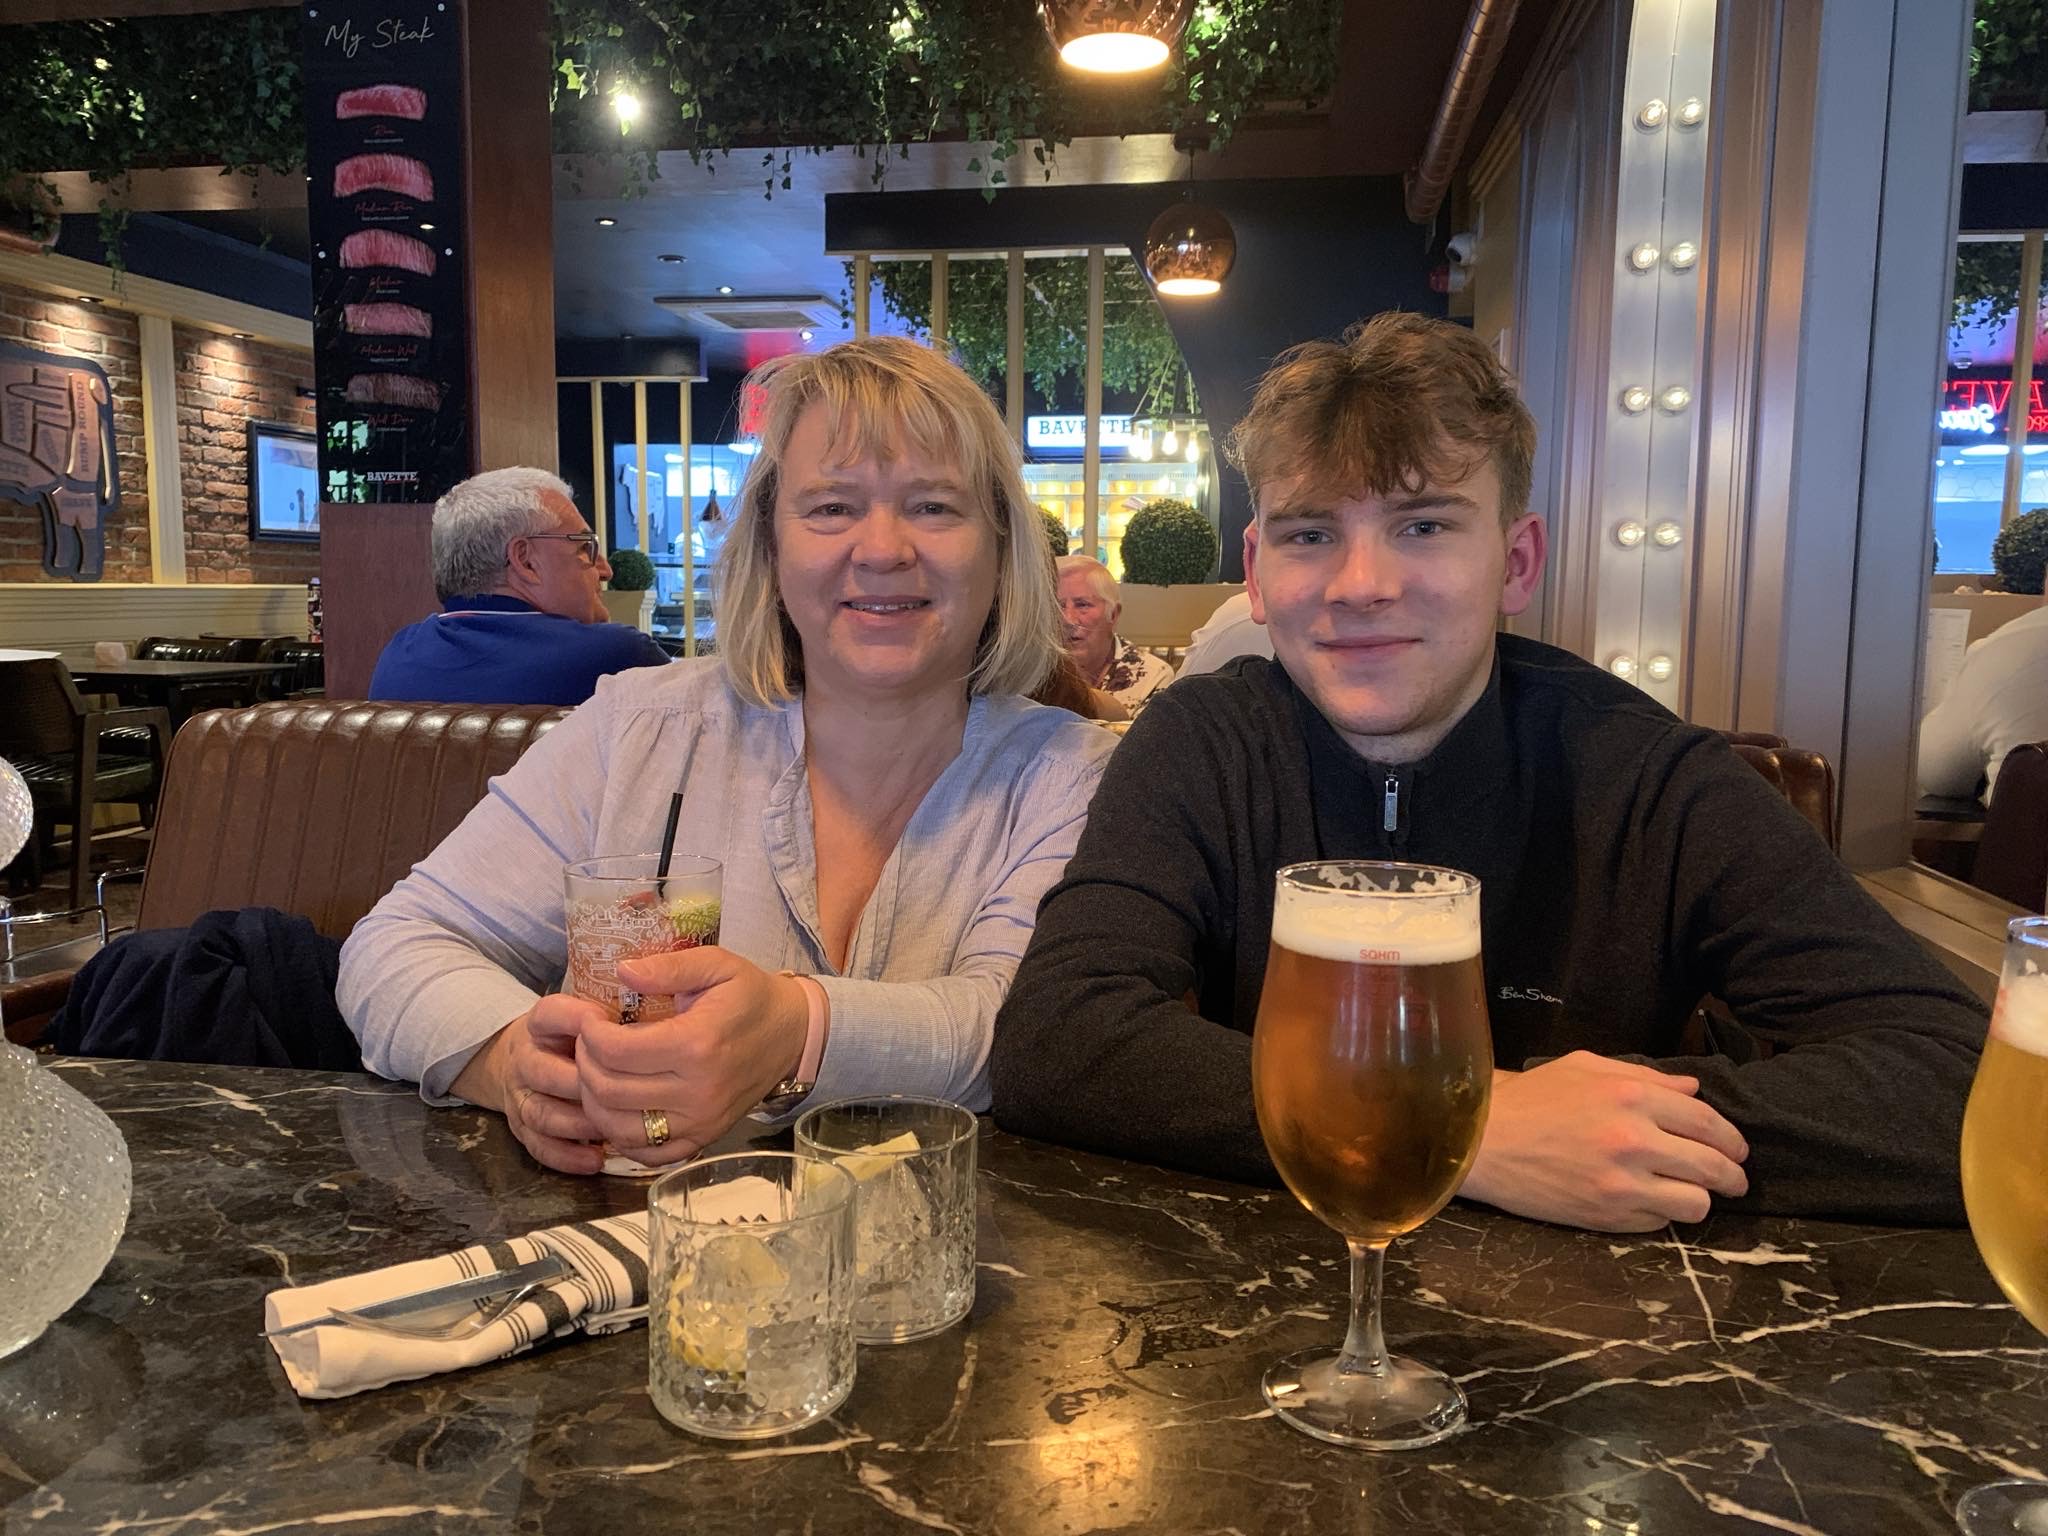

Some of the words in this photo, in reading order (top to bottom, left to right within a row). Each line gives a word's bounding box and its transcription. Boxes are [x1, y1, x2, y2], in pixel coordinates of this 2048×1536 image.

[325, 19, 365, 58] My
[372, 16, 435, 48] Steak
[1039, 420, 1134, 434] BAVETE
[367, 471, 418, 482] BAVETTE
